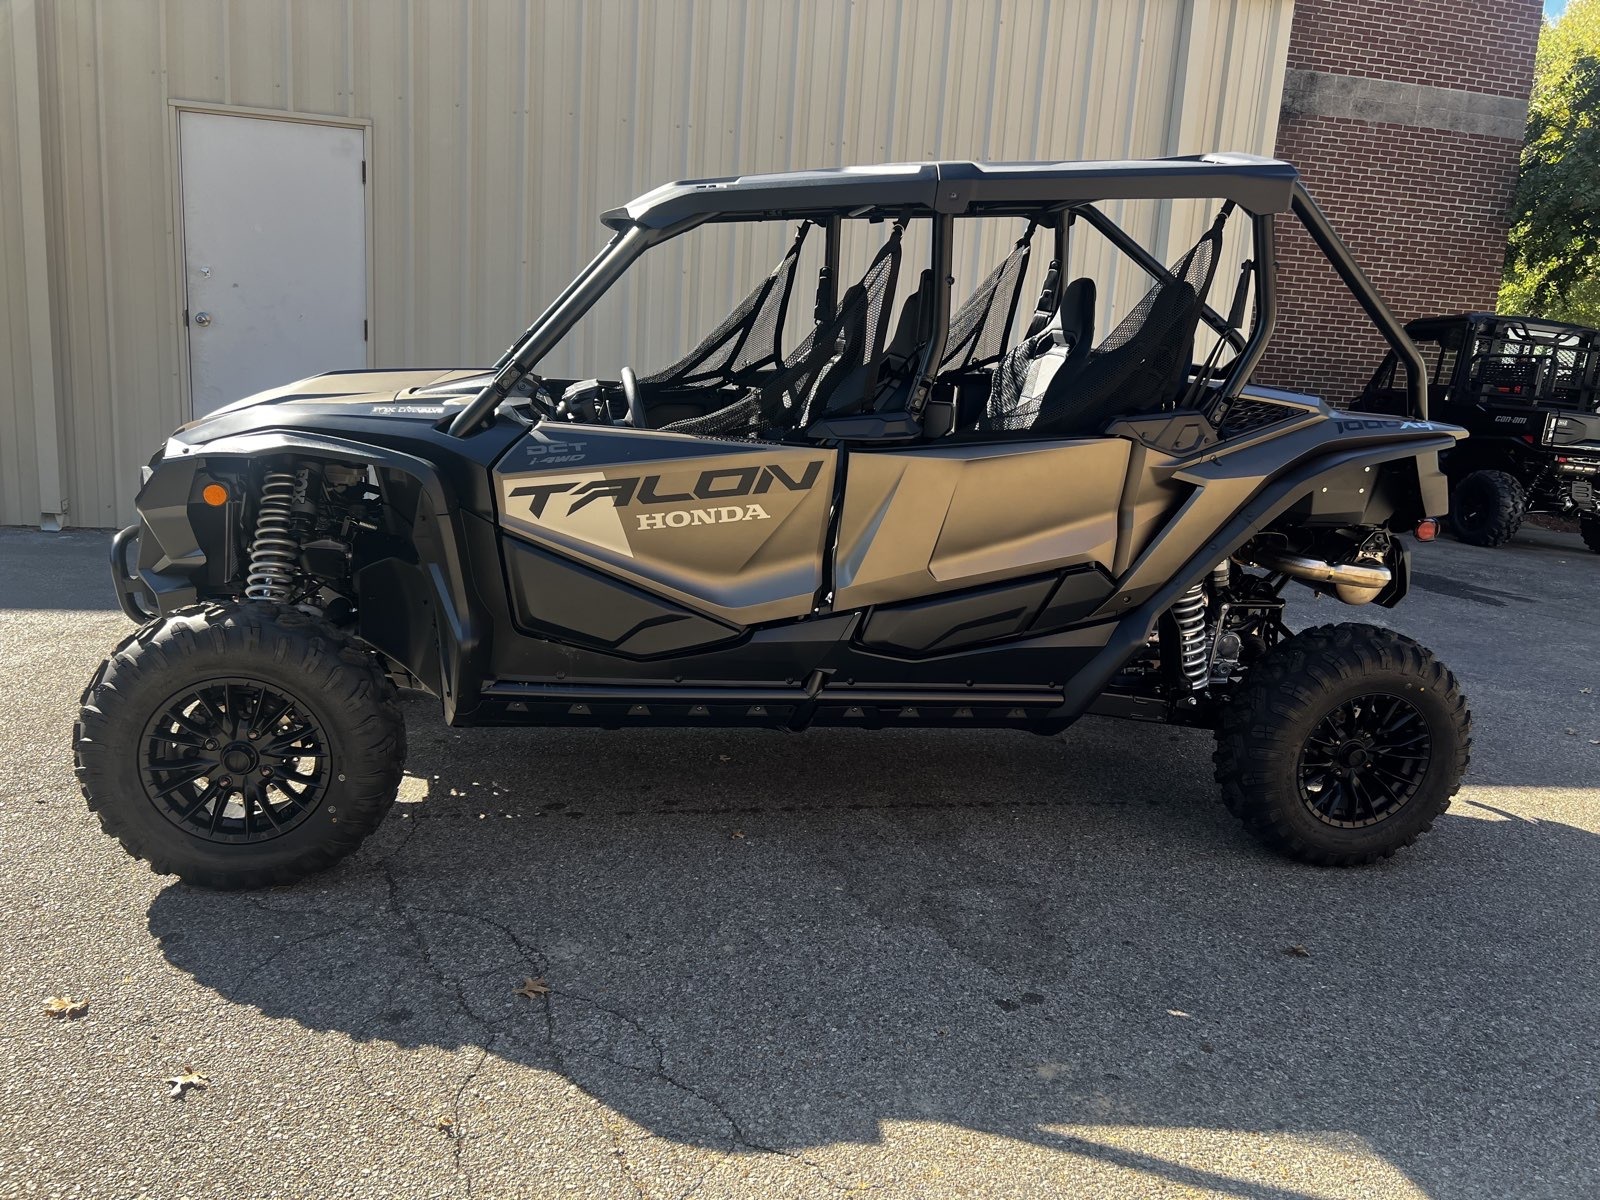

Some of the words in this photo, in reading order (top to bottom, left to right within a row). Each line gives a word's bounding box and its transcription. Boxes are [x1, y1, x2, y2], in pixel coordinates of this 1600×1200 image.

[1494, 415, 1527, 424] can-am
[526, 442, 587, 455] DCT
[508, 460, 824, 520] TALON
[636, 504, 771, 531] HONDA
